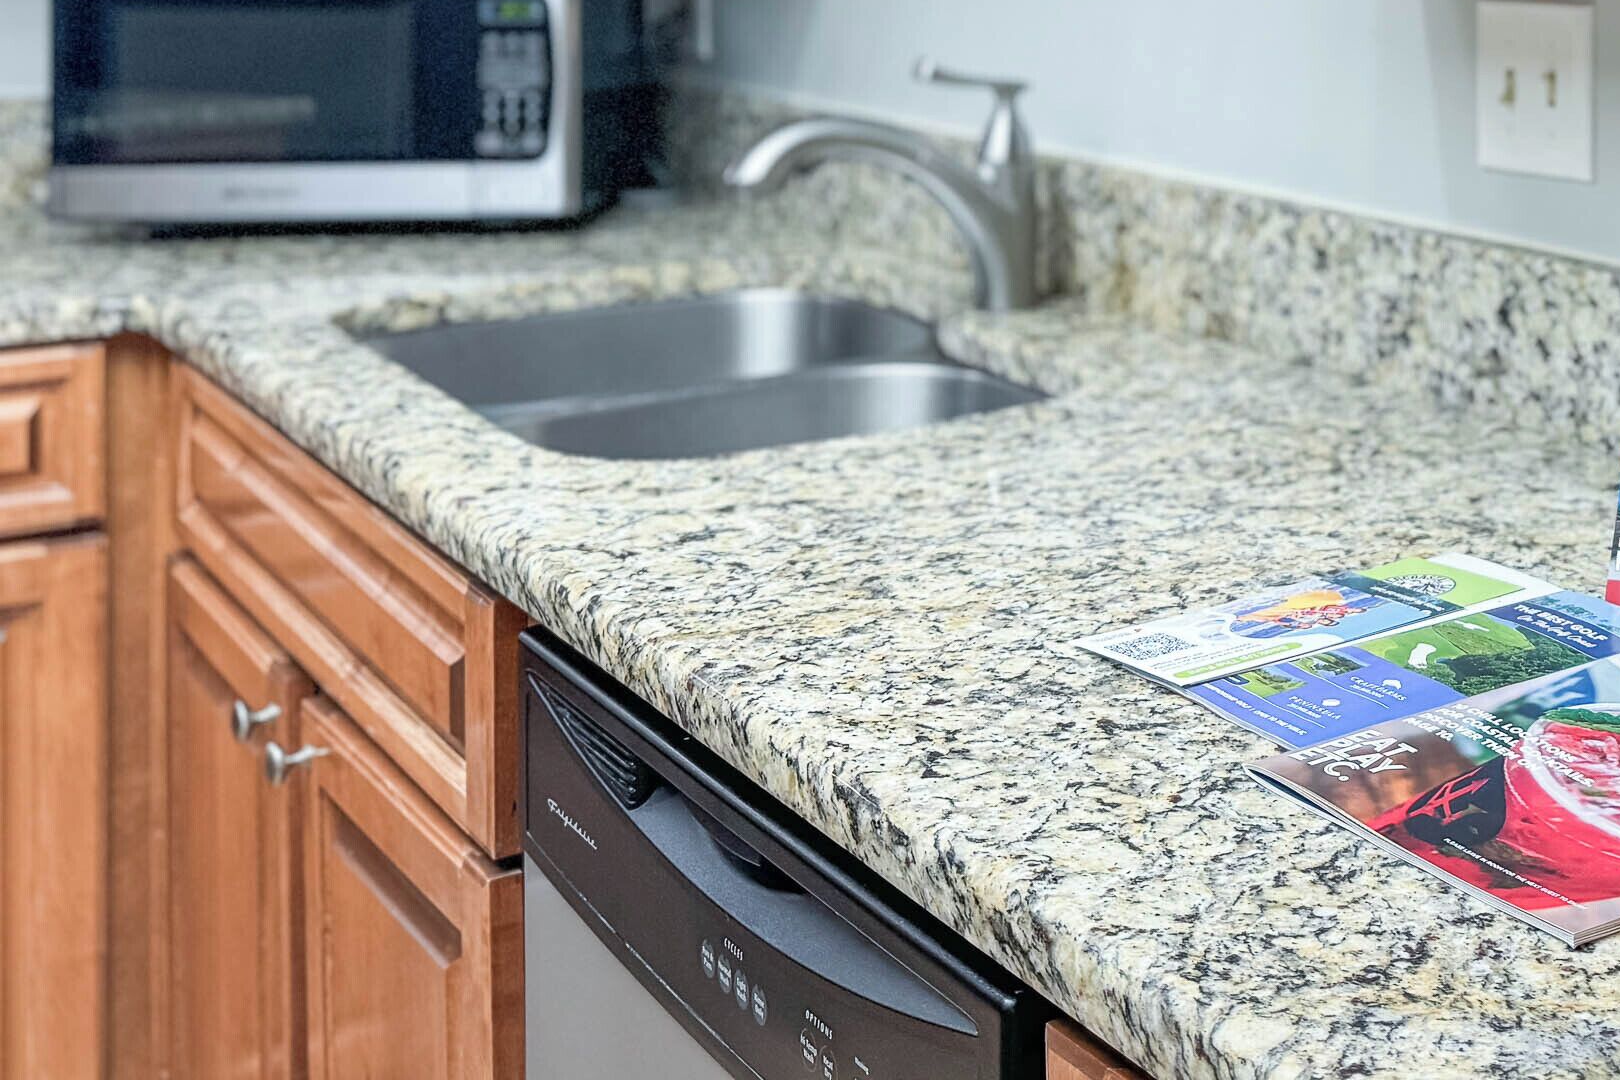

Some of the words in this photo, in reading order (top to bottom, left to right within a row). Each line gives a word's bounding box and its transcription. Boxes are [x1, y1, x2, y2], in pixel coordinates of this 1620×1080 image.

[1514, 604, 1541, 615] THE
[1537, 611, 1574, 626] BEST
[1570, 624, 1609, 641] GOLF
[1347, 729, 1418, 757] EAT
[1403, 717, 1441, 734] PAGE
[1419, 712, 1484, 743] DISCOVER
[1482, 738, 1521, 760] THEM
[1435, 708, 1464, 720] FOR
[1462, 715, 1520, 748] COASTAL
[1466, 706, 1503, 726] CHILL
[1501, 721, 1580, 763] LOCATIONS
[1288, 746, 1360, 781] ETC.
[1319, 738, 1408, 774] PLAY
[724, 937, 744, 961] CYCLES
[805, 1009, 833, 1040] OPTIONS
